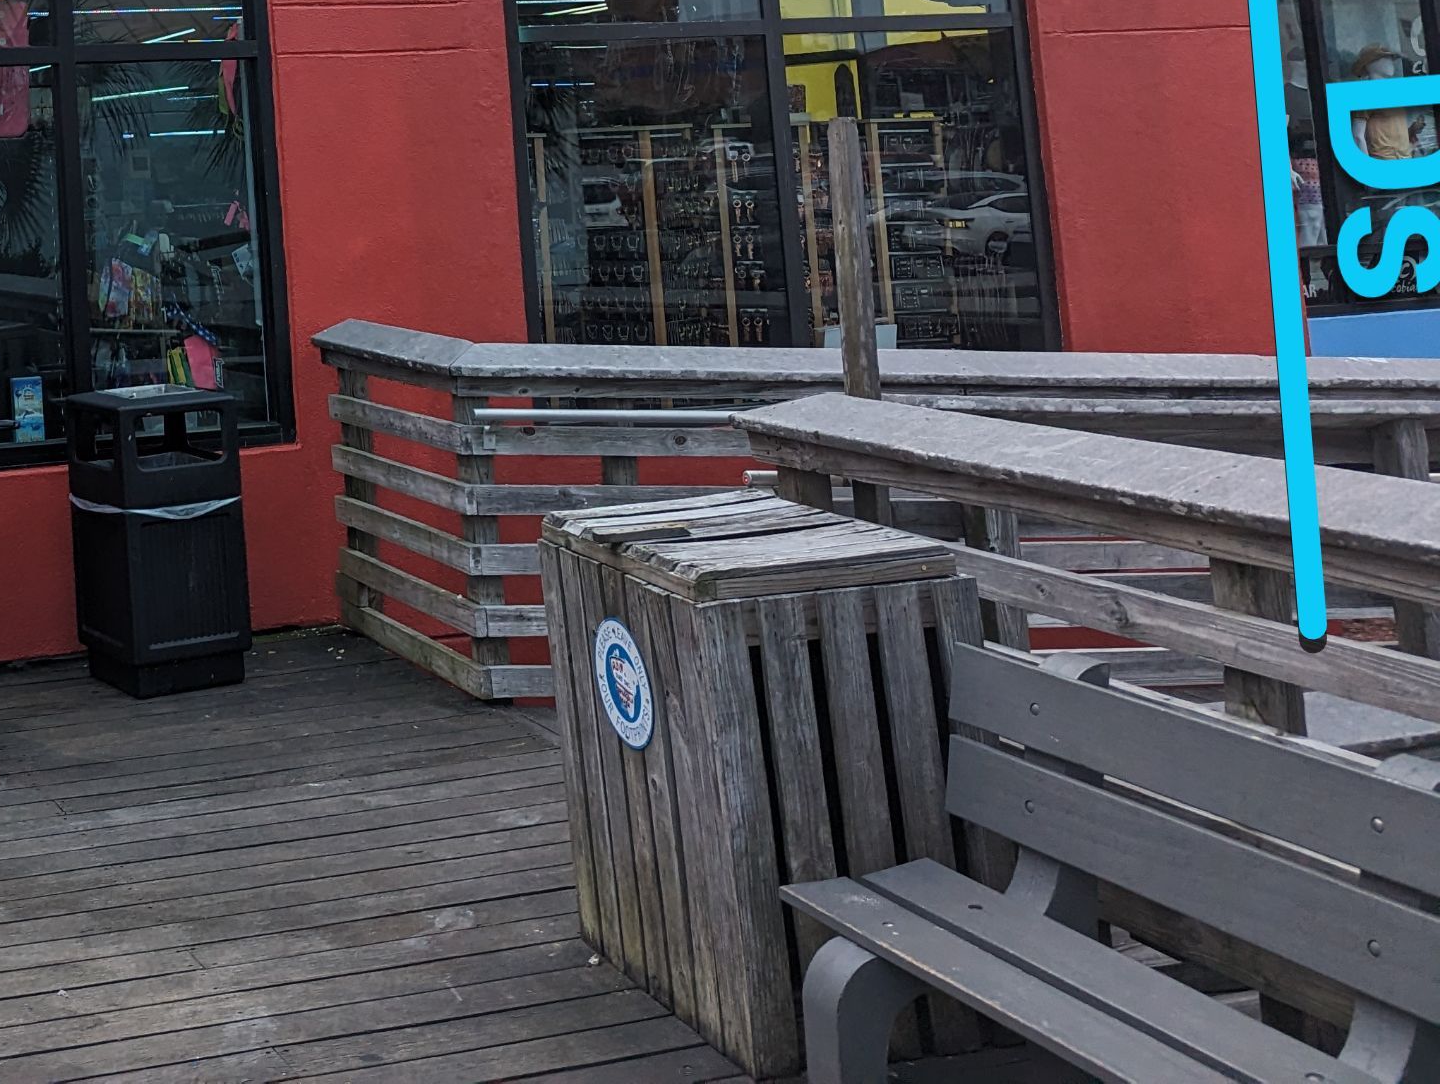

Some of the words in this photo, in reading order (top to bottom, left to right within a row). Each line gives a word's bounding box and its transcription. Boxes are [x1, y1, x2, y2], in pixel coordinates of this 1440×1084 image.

[598, 626, 612, 659] PLEASE
[634, 656, 648, 690] ONLY
[599, 673, 614, 715] YOUR
